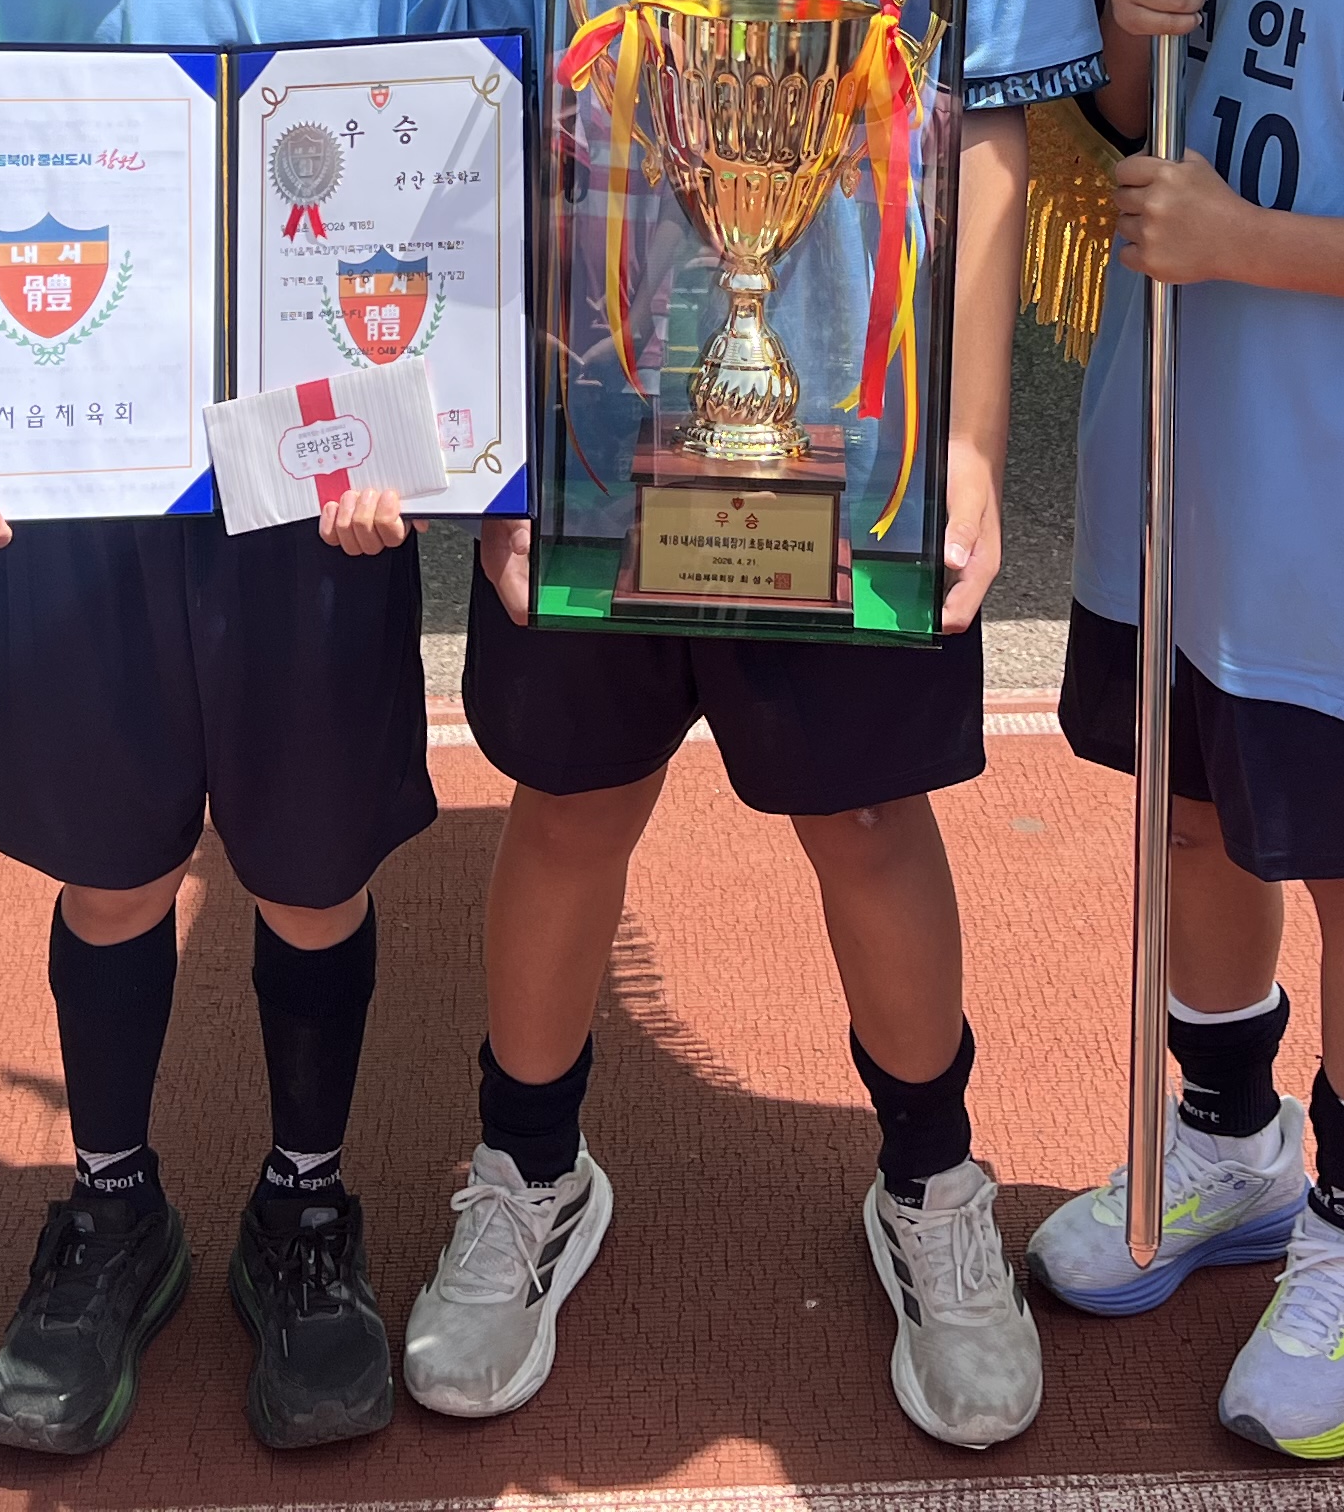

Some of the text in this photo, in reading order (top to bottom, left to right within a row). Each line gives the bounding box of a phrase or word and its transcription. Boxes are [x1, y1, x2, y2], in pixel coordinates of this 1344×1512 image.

[37, 153, 92, 167] 중심도시
[1213, 96, 1300, 212] 10
[23, 274, 72, 312] 體
[364, 304, 400, 341] 體
[295, 431, 355, 458] 문화상품권
[94, 1169, 145, 1192] sport
